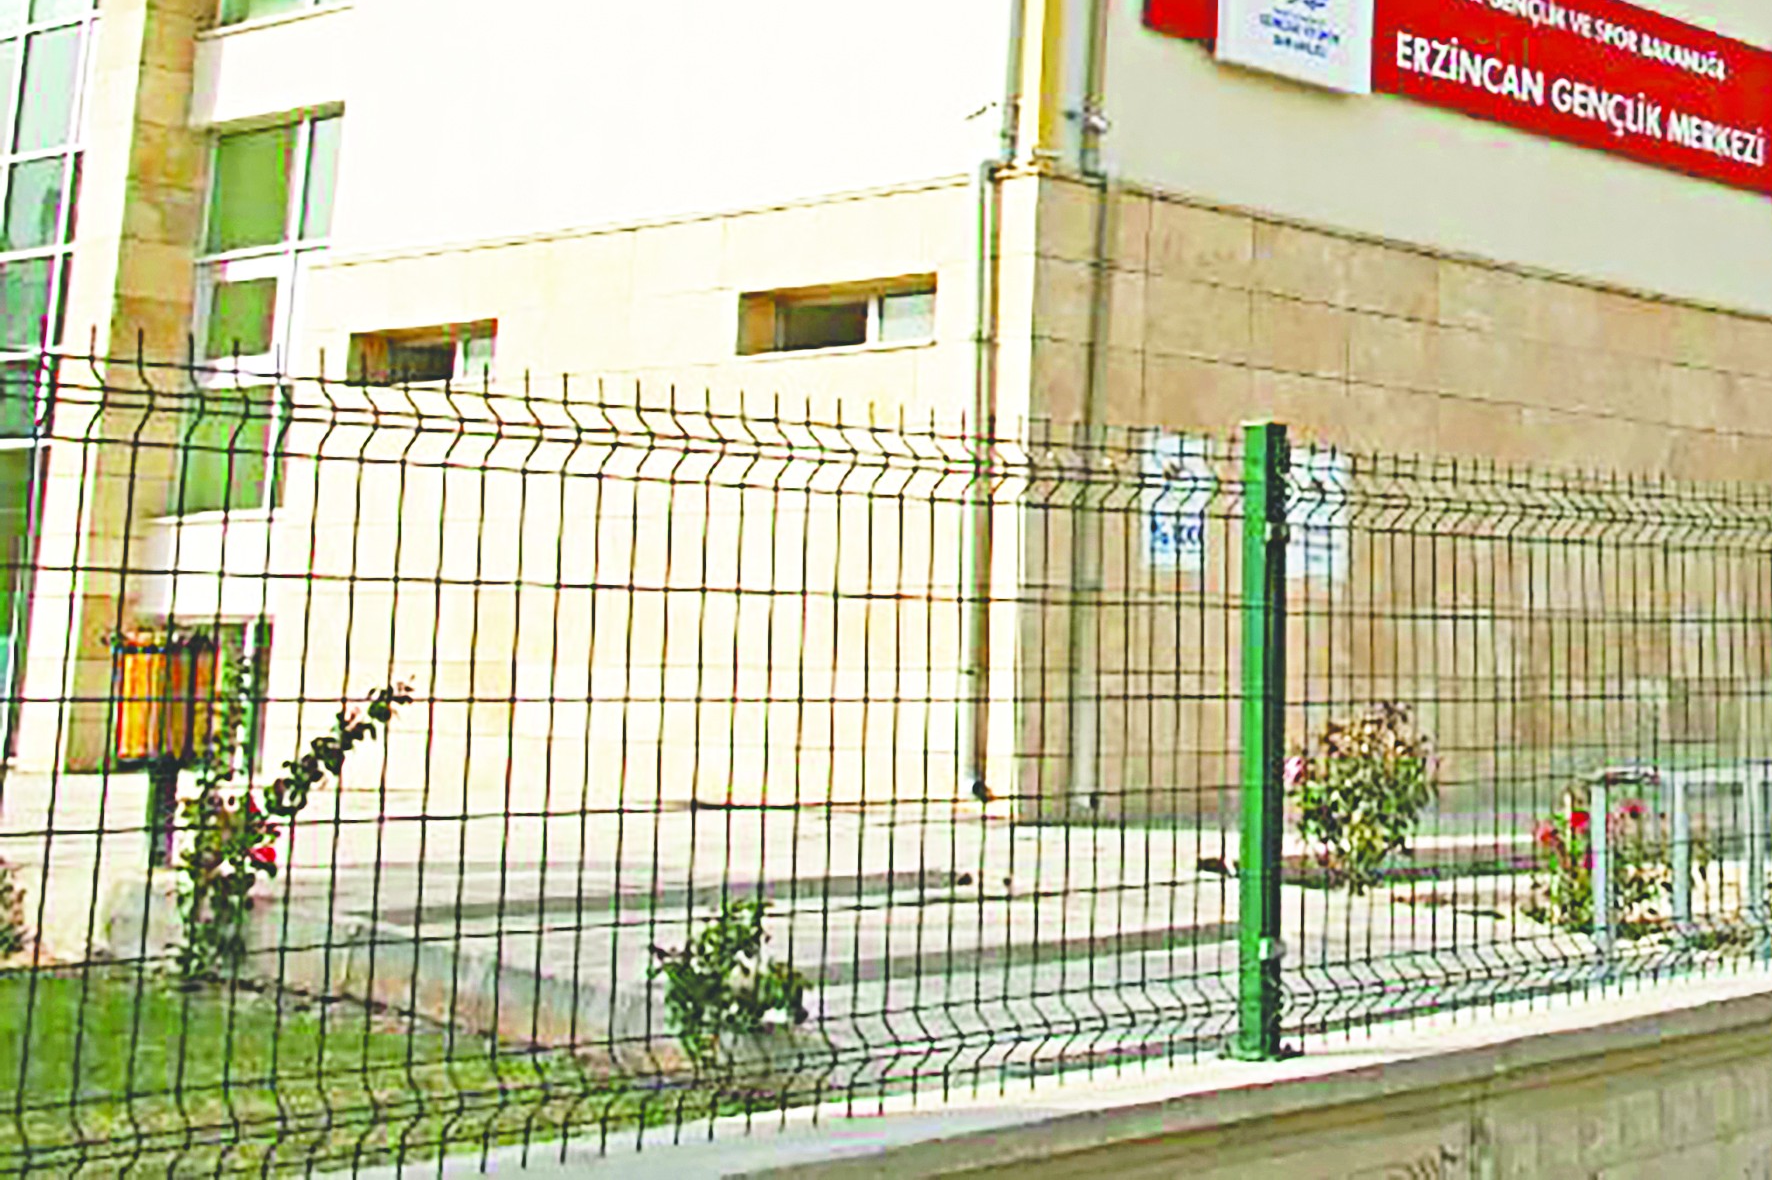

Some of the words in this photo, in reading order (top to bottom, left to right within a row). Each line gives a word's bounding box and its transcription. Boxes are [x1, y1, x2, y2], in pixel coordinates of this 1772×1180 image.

[1568, 8, 1593, 39] VE
[1594, 18, 1638, 53] SPOR
[1396, 30, 1545, 107] ERZİNCAN
[1551, 77, 1663, 138] GENÇLİK
[1666, 108, 1765, 167] MERKEZİ
